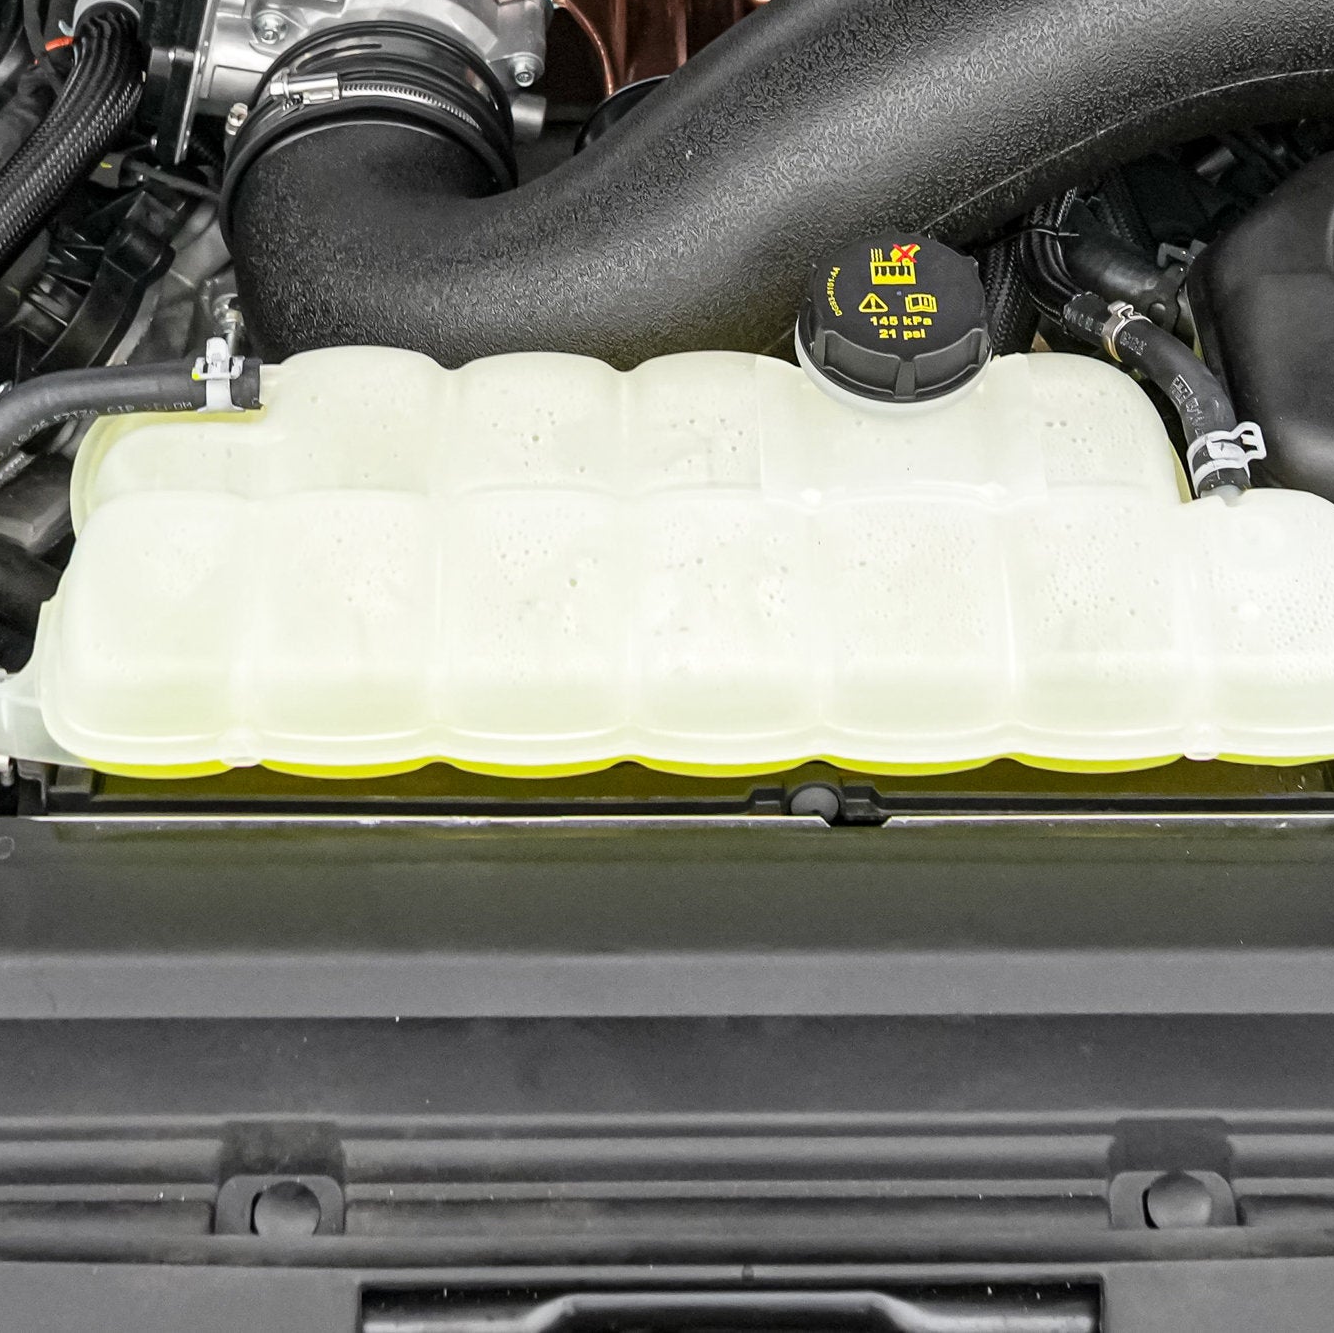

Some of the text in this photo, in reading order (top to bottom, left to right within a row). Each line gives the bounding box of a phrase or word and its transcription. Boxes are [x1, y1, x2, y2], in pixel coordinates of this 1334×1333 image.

[870, 316, 933, 326] 145 kPa
[879, 329, 926, 340] 21 psi
